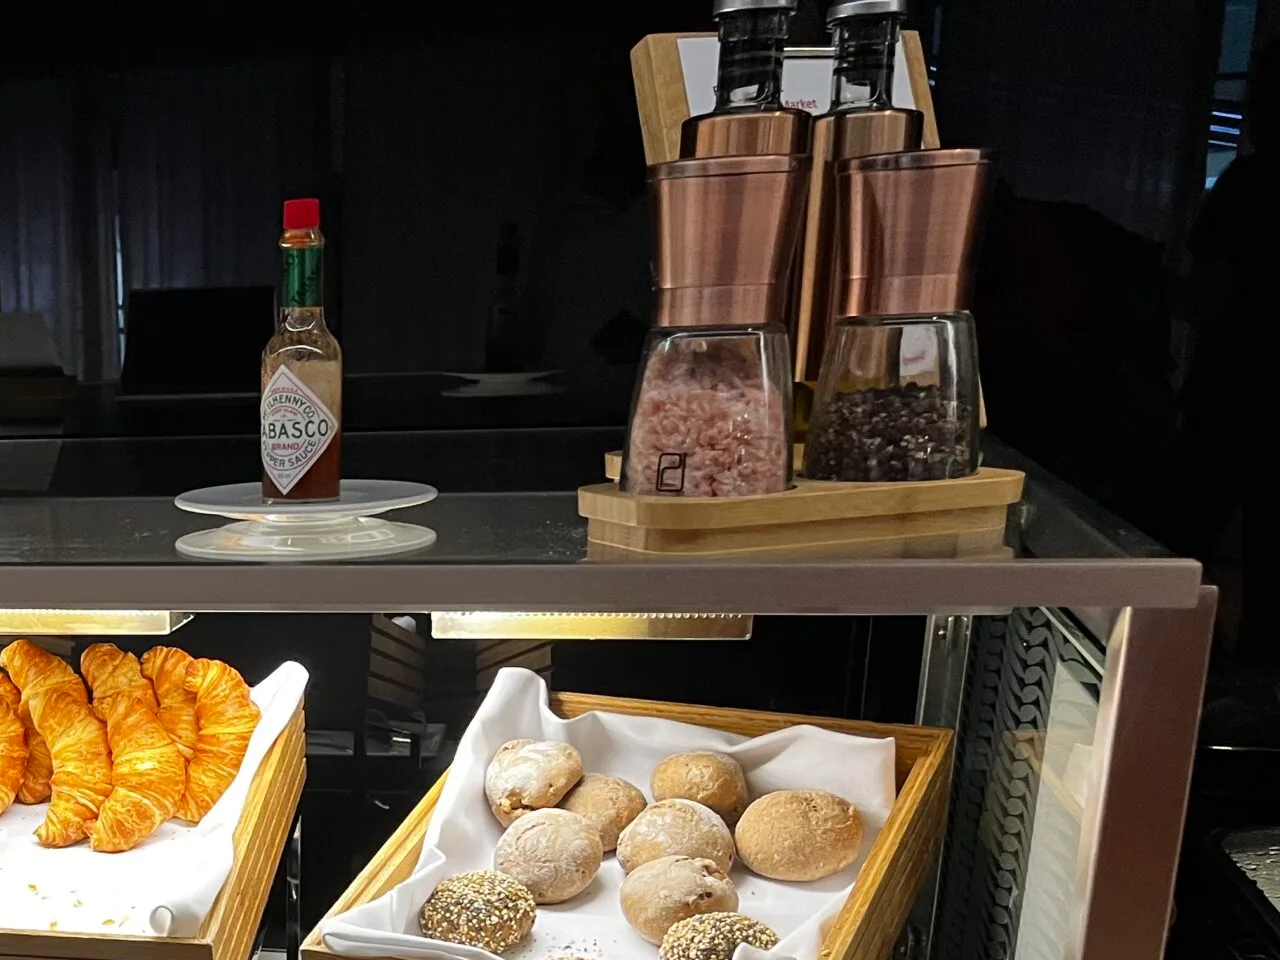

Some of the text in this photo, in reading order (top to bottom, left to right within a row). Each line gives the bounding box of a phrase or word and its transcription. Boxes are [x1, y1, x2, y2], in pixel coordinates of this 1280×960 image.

[263, 419, 329, 439] ABASCO
[271, 442, 300, 451] BRAND
[287, 439, 317, 468] SAUCE
